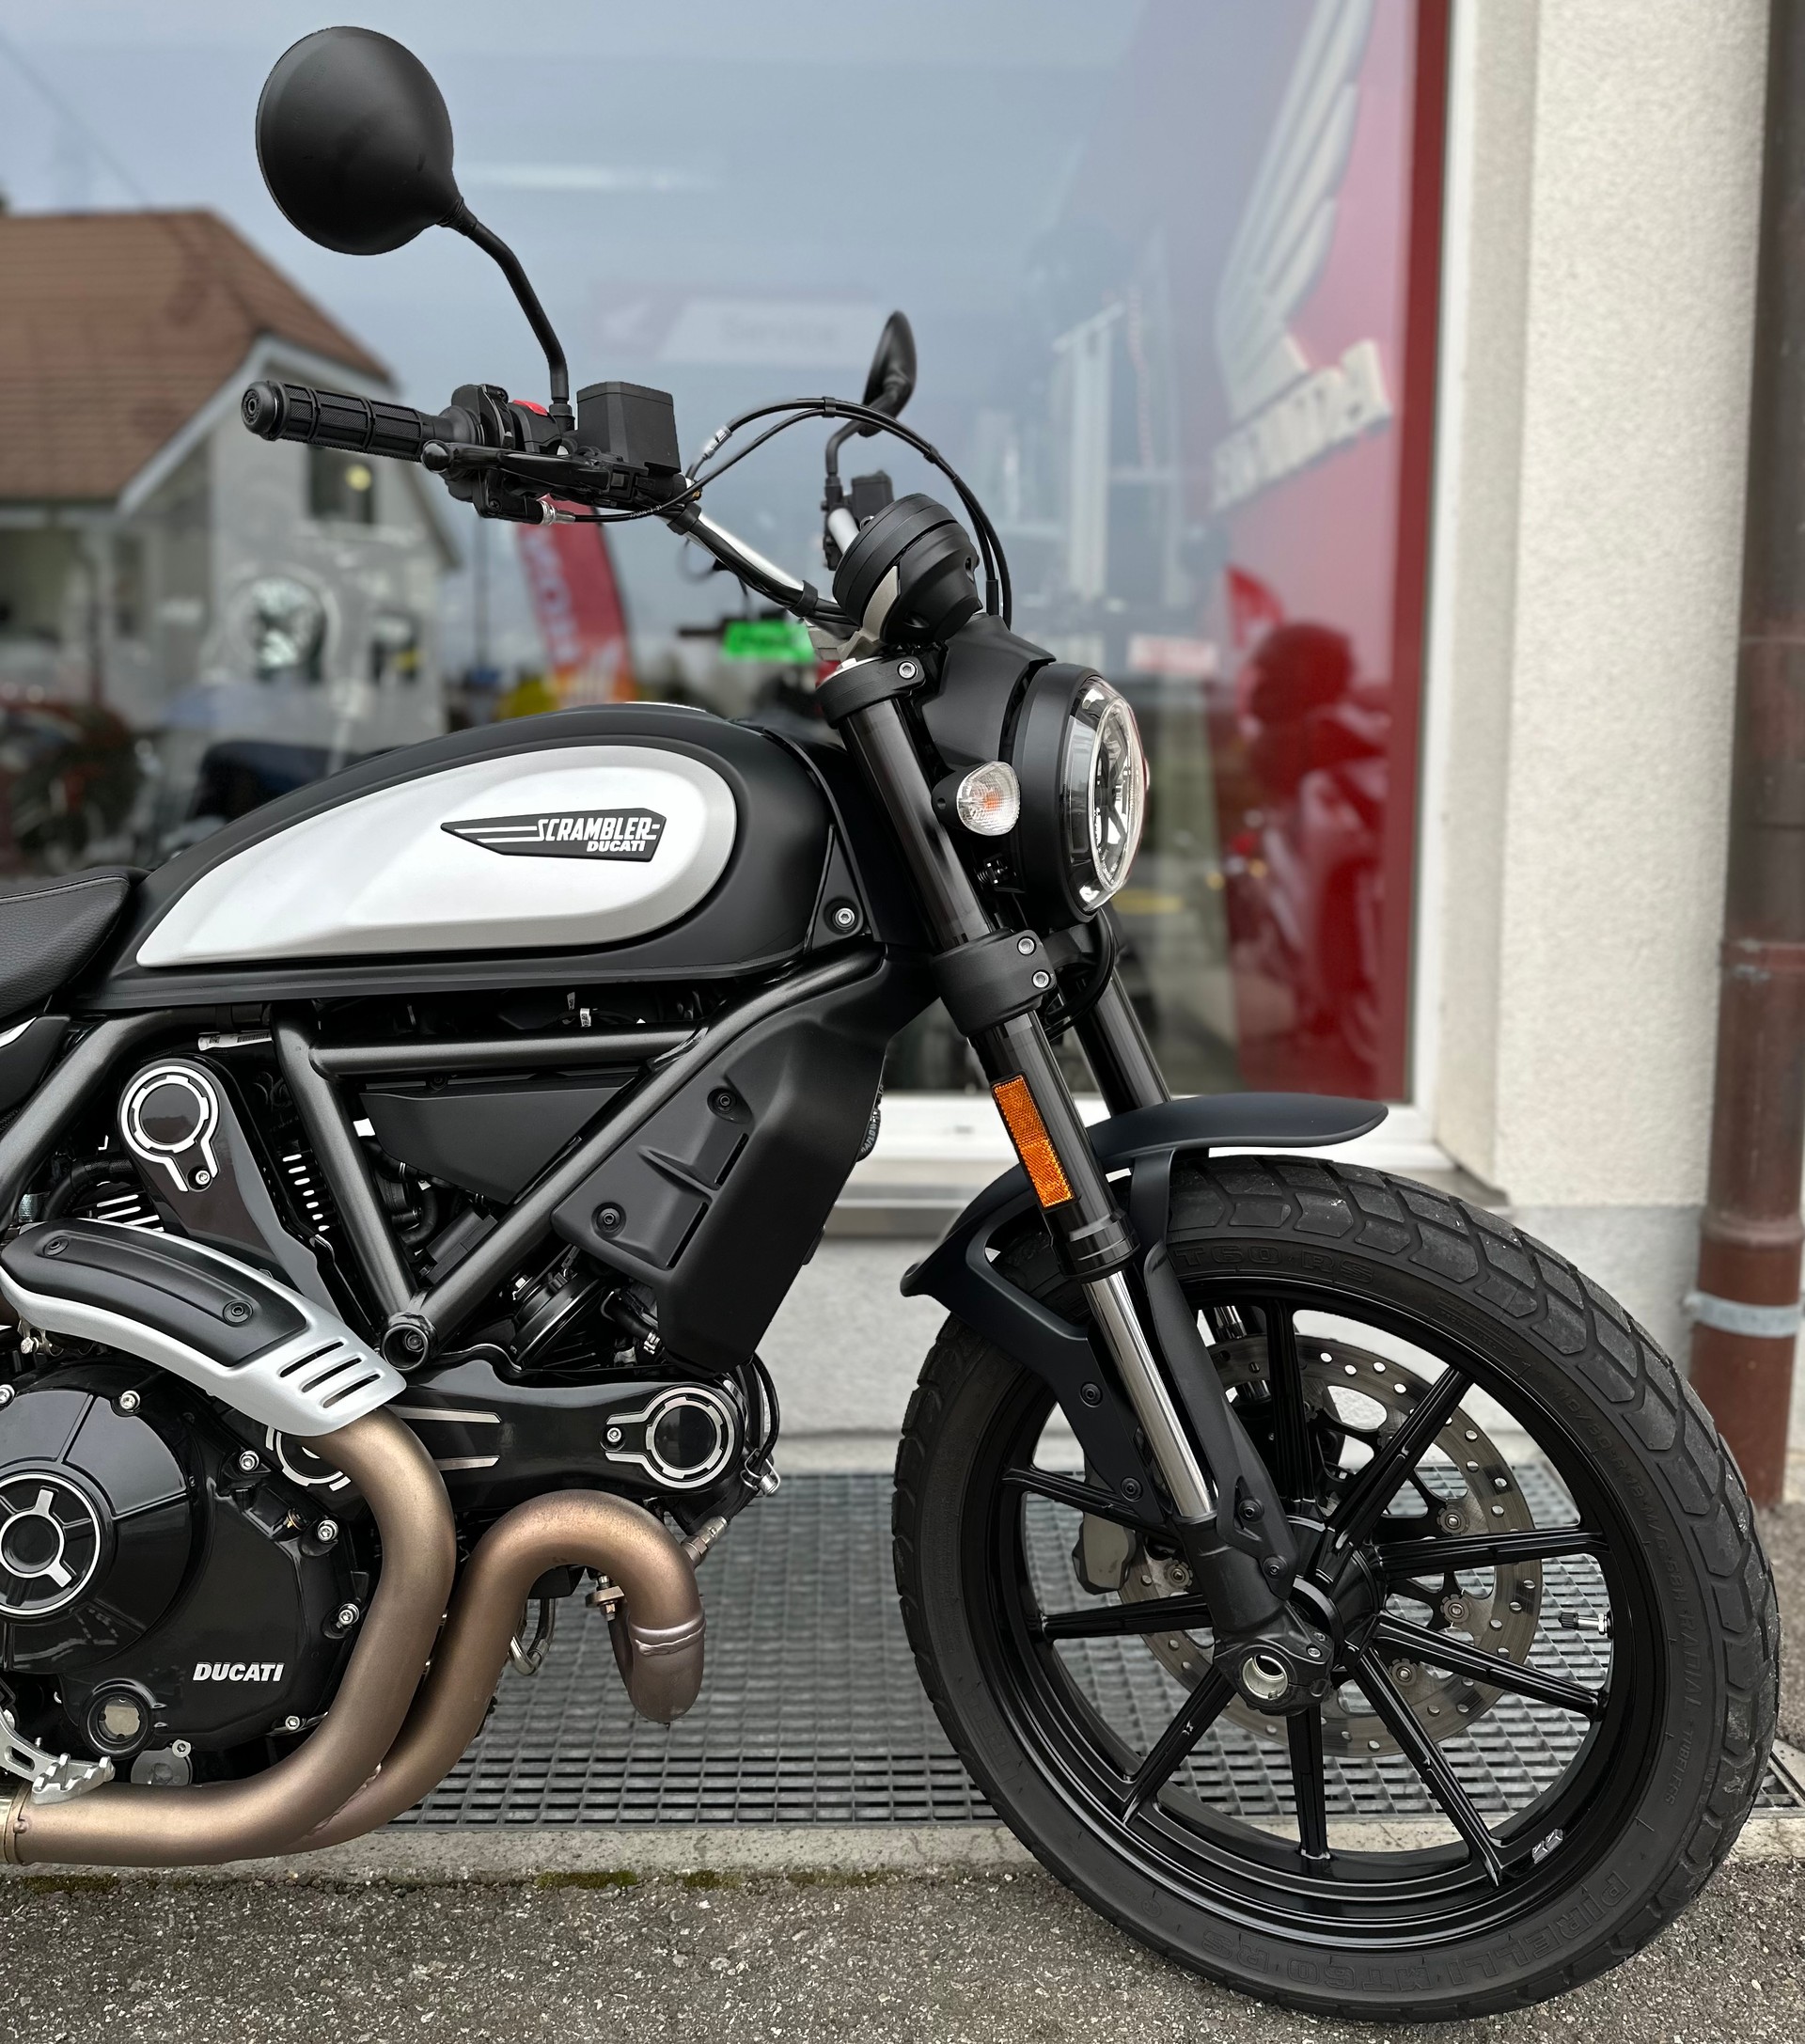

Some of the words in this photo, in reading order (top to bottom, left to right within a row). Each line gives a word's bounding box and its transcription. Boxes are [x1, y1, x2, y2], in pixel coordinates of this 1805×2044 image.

[537, 817, 658, 841] SCRAMBLER
[587, 841, 646, 853] DUCATI
[1174, 1244, 1282, 1266] T60
[1301, 1250, 1374, 1284] RS
[193, 1661, 285, 1681] DUCATI
[1678, 1613, 1703, 1708] RADIAL
[1449, 1870, 1633, 1986] PIRELLI
[1201, 1928, 1270, 1974] RS
[1288, 1958, 1434, 1993] MT60
